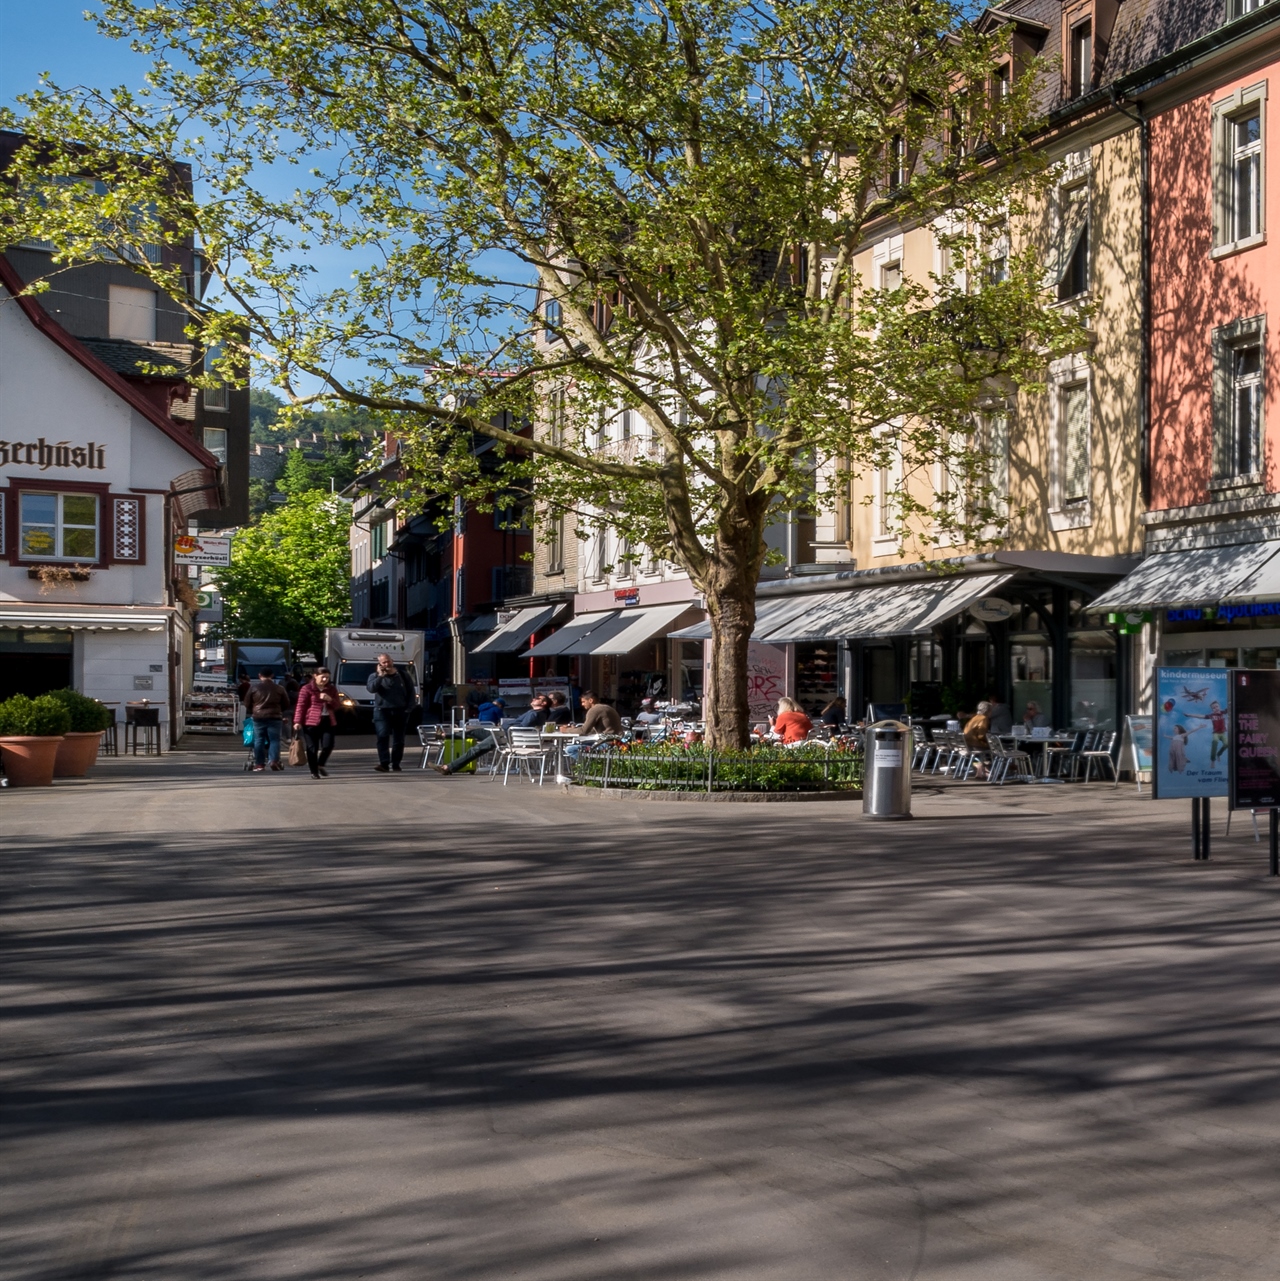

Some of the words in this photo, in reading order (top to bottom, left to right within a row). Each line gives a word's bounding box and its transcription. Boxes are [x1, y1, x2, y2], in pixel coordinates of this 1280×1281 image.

[1238, 719, 1259, 730] THE
[1239, 733, 1269, 744] FAIRY
[1239, 747, 1278, 757] QUEEN
